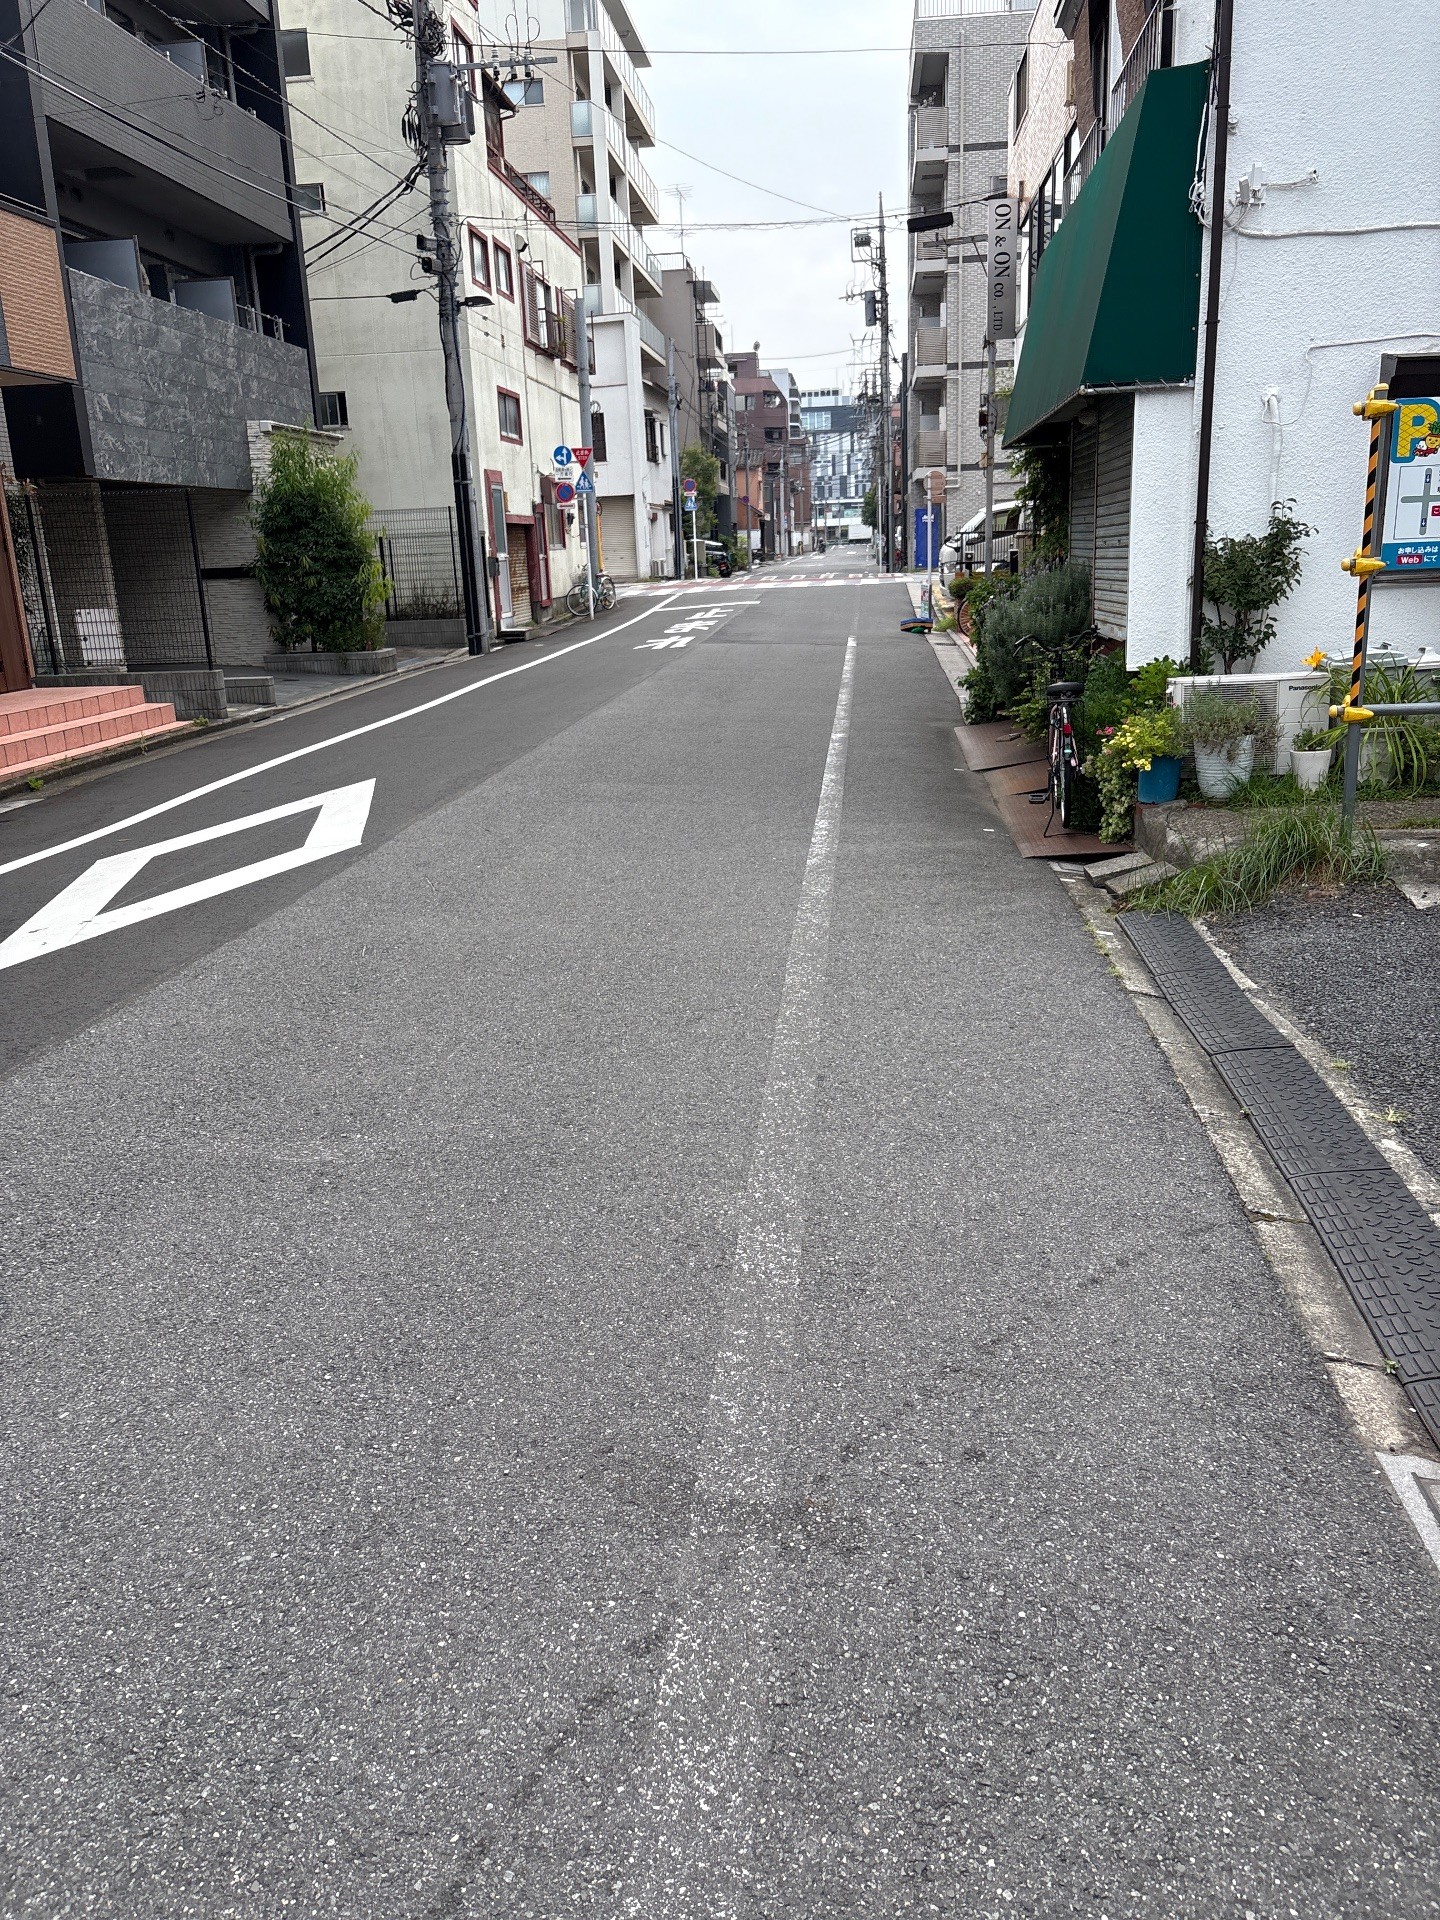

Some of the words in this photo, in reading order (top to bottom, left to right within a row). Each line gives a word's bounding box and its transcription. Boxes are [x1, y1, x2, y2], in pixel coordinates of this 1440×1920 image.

[994, 203, 1012, 231] ON
[994, 235, 1007, 247] &
[993, 251, 1011, 278] ON
[1396, 403, 1438, 458] P
[1398, 546, 1439, 555] お申し込みは
[1401, 556, 1420, 564] Web
[633, 608, 734, 650] 止まれ
